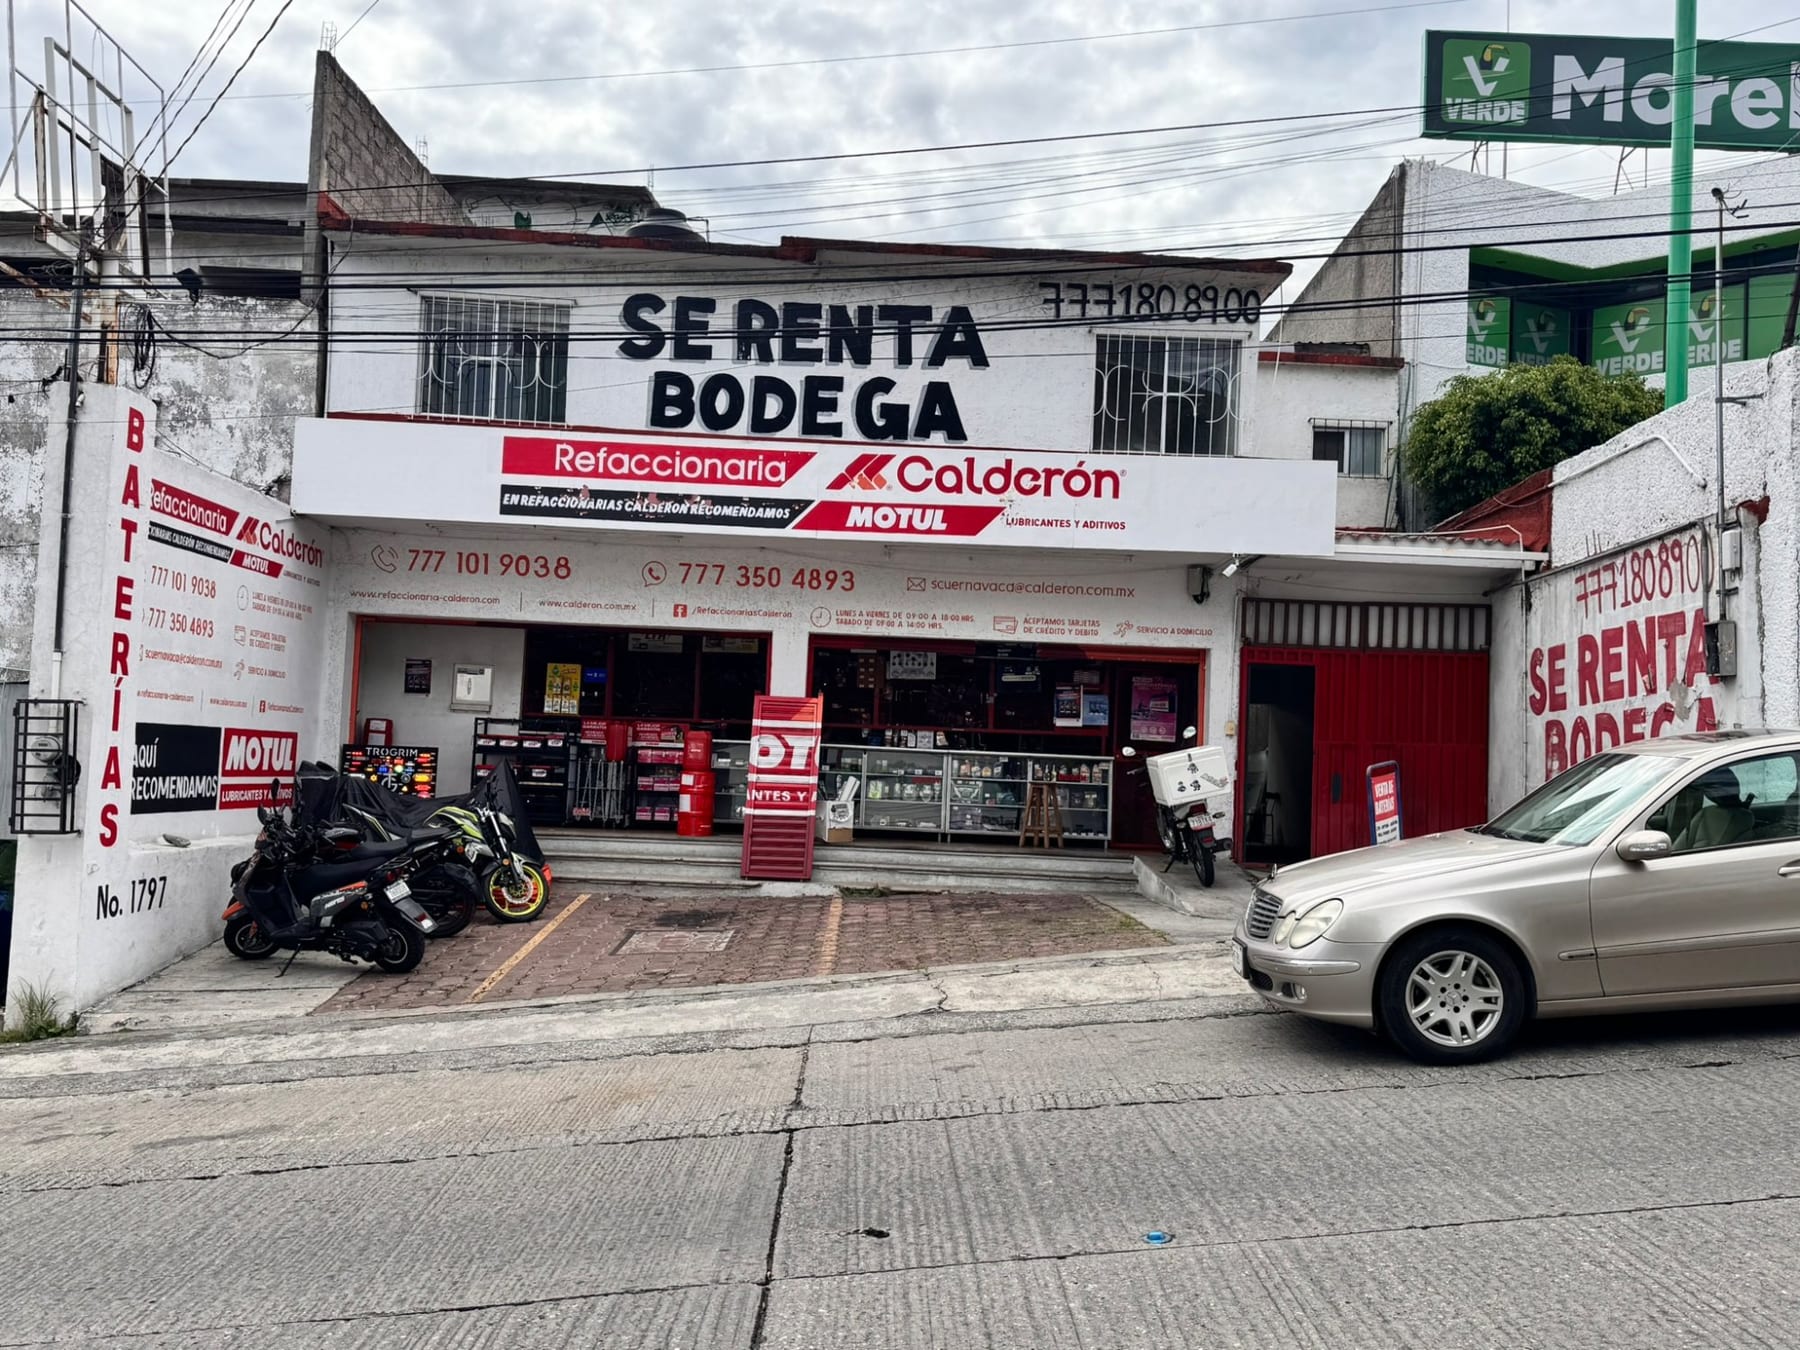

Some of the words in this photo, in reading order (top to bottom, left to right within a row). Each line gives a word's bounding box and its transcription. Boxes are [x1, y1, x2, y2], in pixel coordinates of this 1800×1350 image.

[1445, 97, 1525, 124] VERDE
[619, 293, 716, 361] SE
[734, 299, 990, 368] RENTA
[1596, 350, 1664, 376] VERDE
[649, 370, 968, 441] BODEGA
[555, 443, 787, 483] Refaccionaria
[897, 455, 1121, 499] Calderón
[503, 494, 520, 506] EN
[689, 501, 791, 520] RECOMENDAMOS
[846, 505, 948, 531] MOTUL
[1006, 517, 1072, 529] LUBRICANTES
[1074, 519, 1080, 529] Y
[1082, 519, 1126, 531] ADITIVOS
[259, 522, 323, 569] Calderón
[242, 553, 269, 574] MOTUL
[408, 549, 446, 573] 777
[456, 551, 489, 575] 101
[499, 553, 571, 580] 9038
[678, 562, 726, 585] 777
[735, 565, 782, 588] 350
[791, 568, 856, 592] 4893
[151, 565, 169, 587] 777
[171, 572, 187, 592] 101
[191, 576, 217, 599] 9038
[931, 577, 1135, 598] scuernavaca@calderon.com.mx
[350, 589, 500, 605] www.refaccionaria-calderon.com
[538, 598, 637, 612] www.calderon.com.mx
[892, 611, 902, 619] DE
[100, 406, 147, 848] BATERÍAS
[148, 607, 166, 629] 777
[169, 612, 187, 633] 350
[189, 616, 214, 638] 4893
[1023, 617, 1065, 626] ACEPTAMOS
[1023, 626, 1033, 634] DE
[1067, 628, 1073, 636] Y
[1136, 626, 1169, 635] SERVICIO
[1176, 628, 1213, 637] DOMICILIO
[1529, 643, 1567, 717] SE
[1577, 607, 1720, 707] RENTA
[225, 735, 294, 771] MOTUL
[365, 747, 418, 758] TROGRIM
[750, 734, 820, 770] OT
[221, 789, 263, 803] LUBRICANTES
[263, 789, 268, 800] Y
[796, 791, 807, 802] Y
[96, 884, 123, 920] No.
[130, 875, 168, 914] 1797
